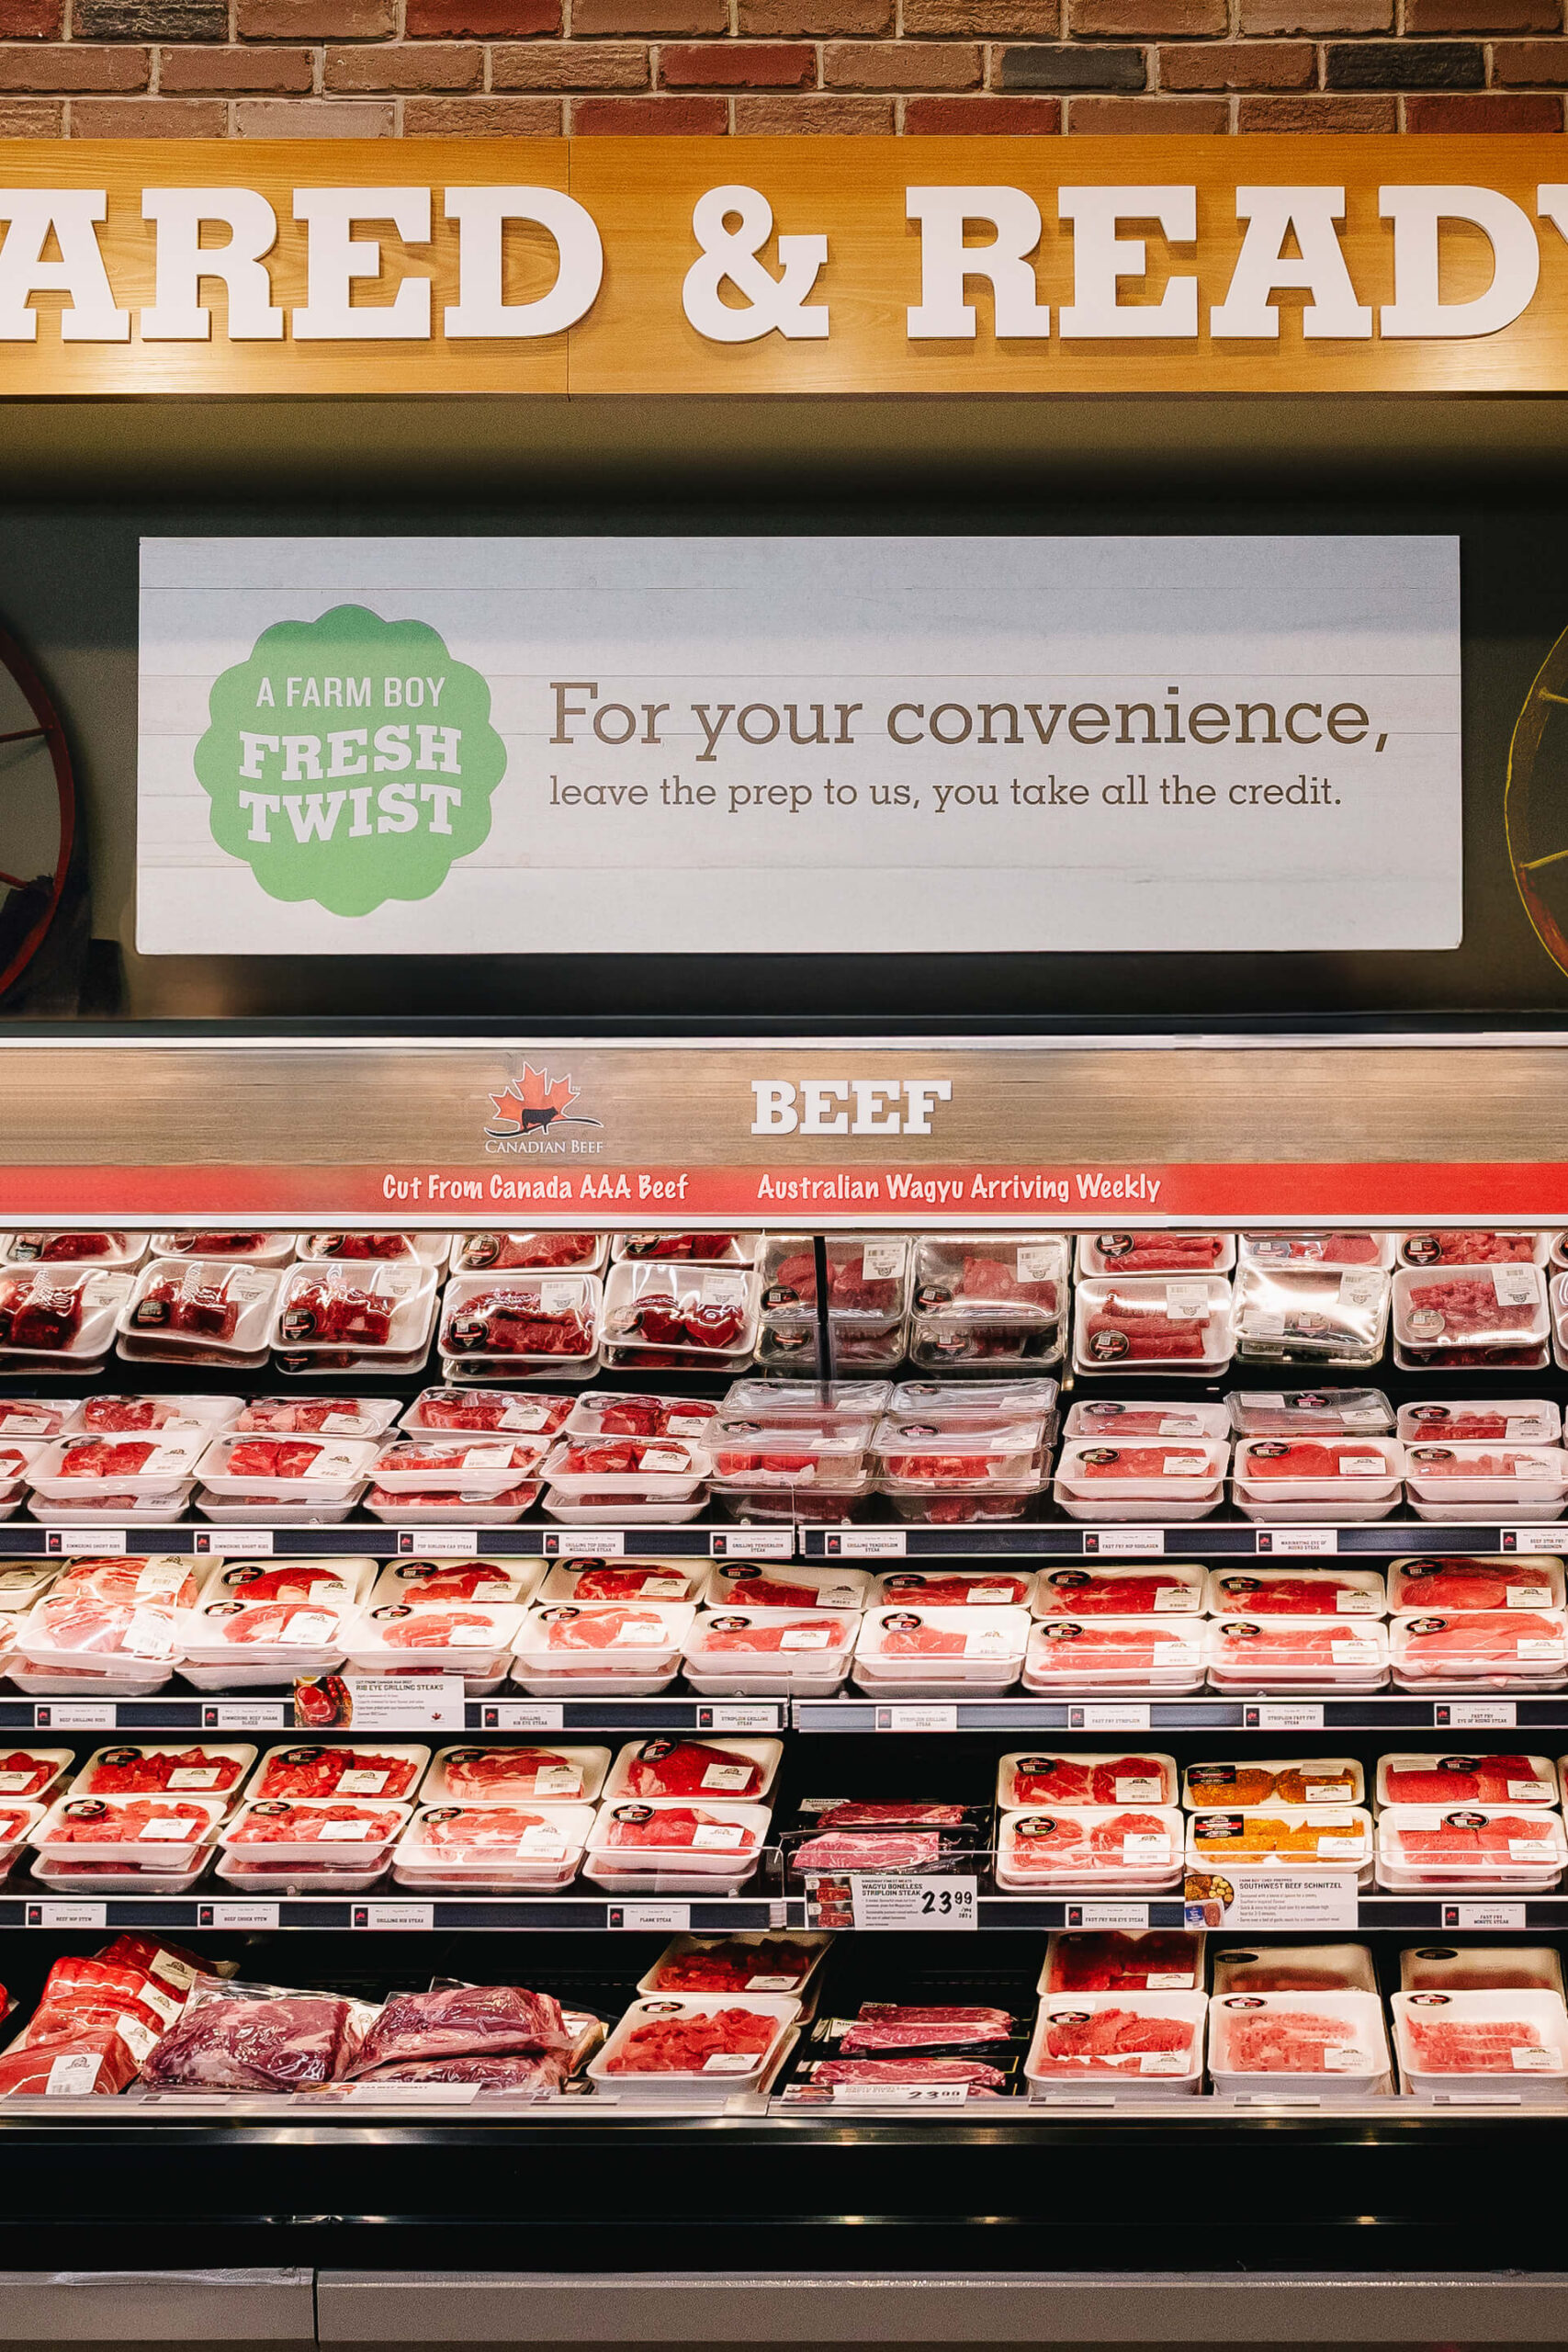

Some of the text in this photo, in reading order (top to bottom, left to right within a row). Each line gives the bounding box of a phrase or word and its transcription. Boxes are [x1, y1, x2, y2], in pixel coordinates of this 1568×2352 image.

[682, 184, 830, 344] &
[905, 184, 1568, 341] READ
[255, 676, 446, 707] A FARM BOY
[549, 682, 1389, 762] For your convenience,
[238, 724, 462, 781] FRESH
[238, 783, 462, 843] TWIST
[549, 774, 1342, 813] leave the prep to us, you take all the credit.
[750, 1079, 953, 1136] BEEF
[484, 1139, 604, 1154] CANADIAN BEEF
[382, 1173, 690, 1201] Cut From Canada AAA Beef
[757, 1172, 1161, 1204] Australian Wagyu Arriving Weekly
